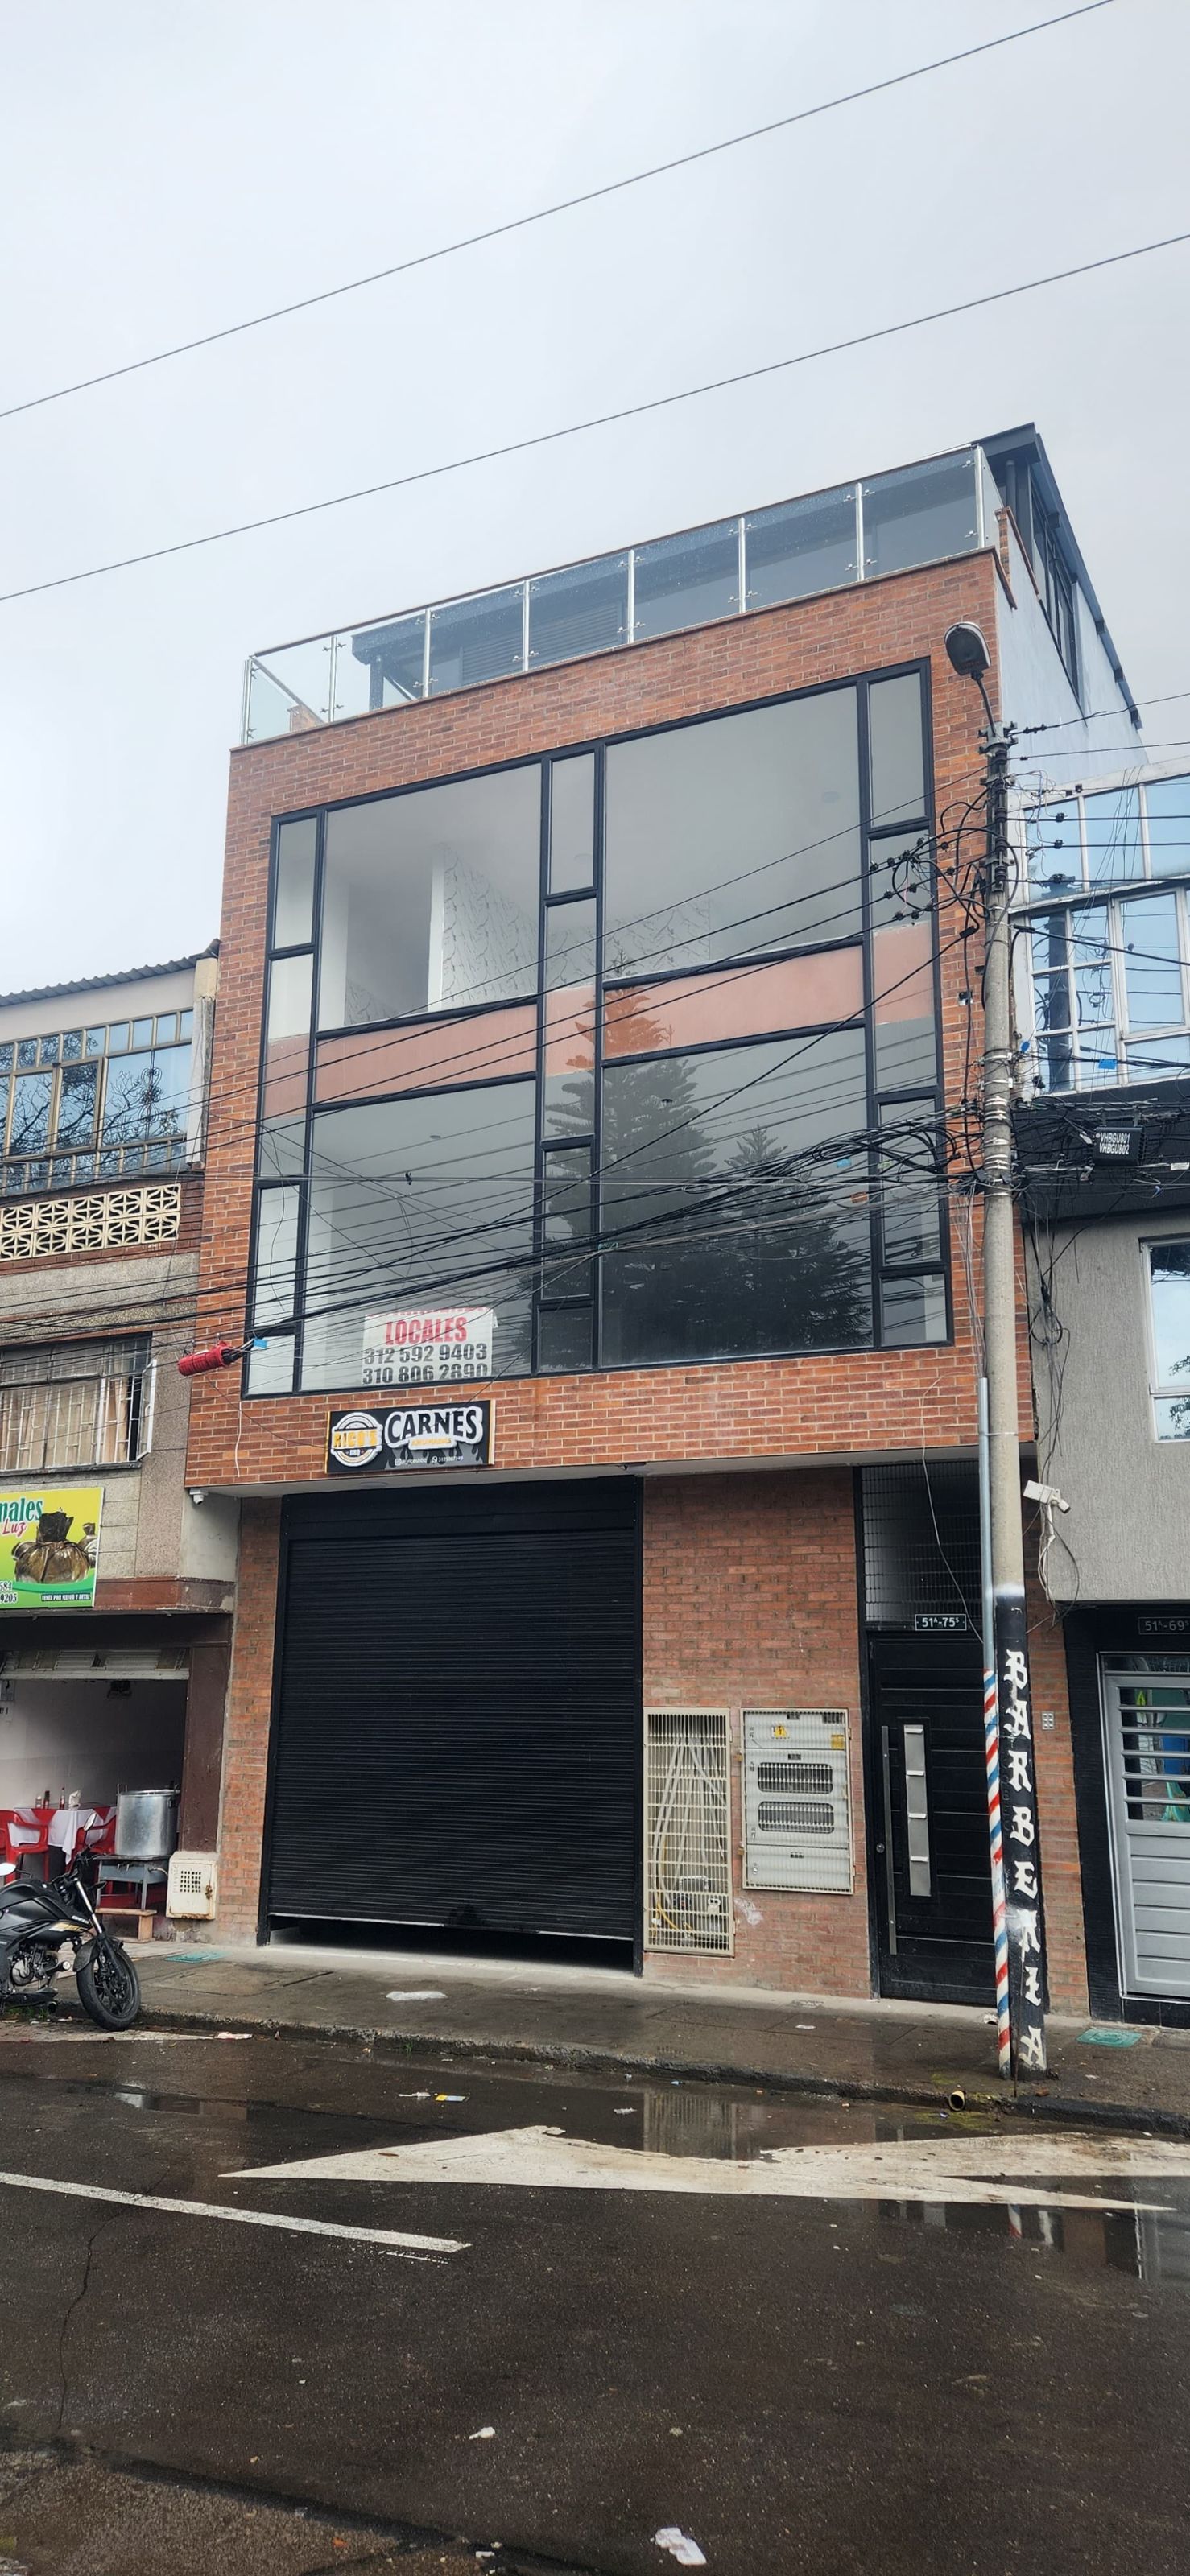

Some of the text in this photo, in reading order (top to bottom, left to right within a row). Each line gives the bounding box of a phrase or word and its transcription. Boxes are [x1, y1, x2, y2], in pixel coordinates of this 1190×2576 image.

[1099, 1142, 1130, 1154] VHBGU802
[1100, 1132, 1130, 1144] VHBGU801
[386, 1316, 468, 1345] LOCALES
[364, 1343, 487, 1365] 312 592 9403
[362, 1367, 393, 1385] 310
[398, 1364, 434, 1382] 806
[387, 1409, 477, 1443] CARNES
[2, 1518, 27, 1537] Luz
